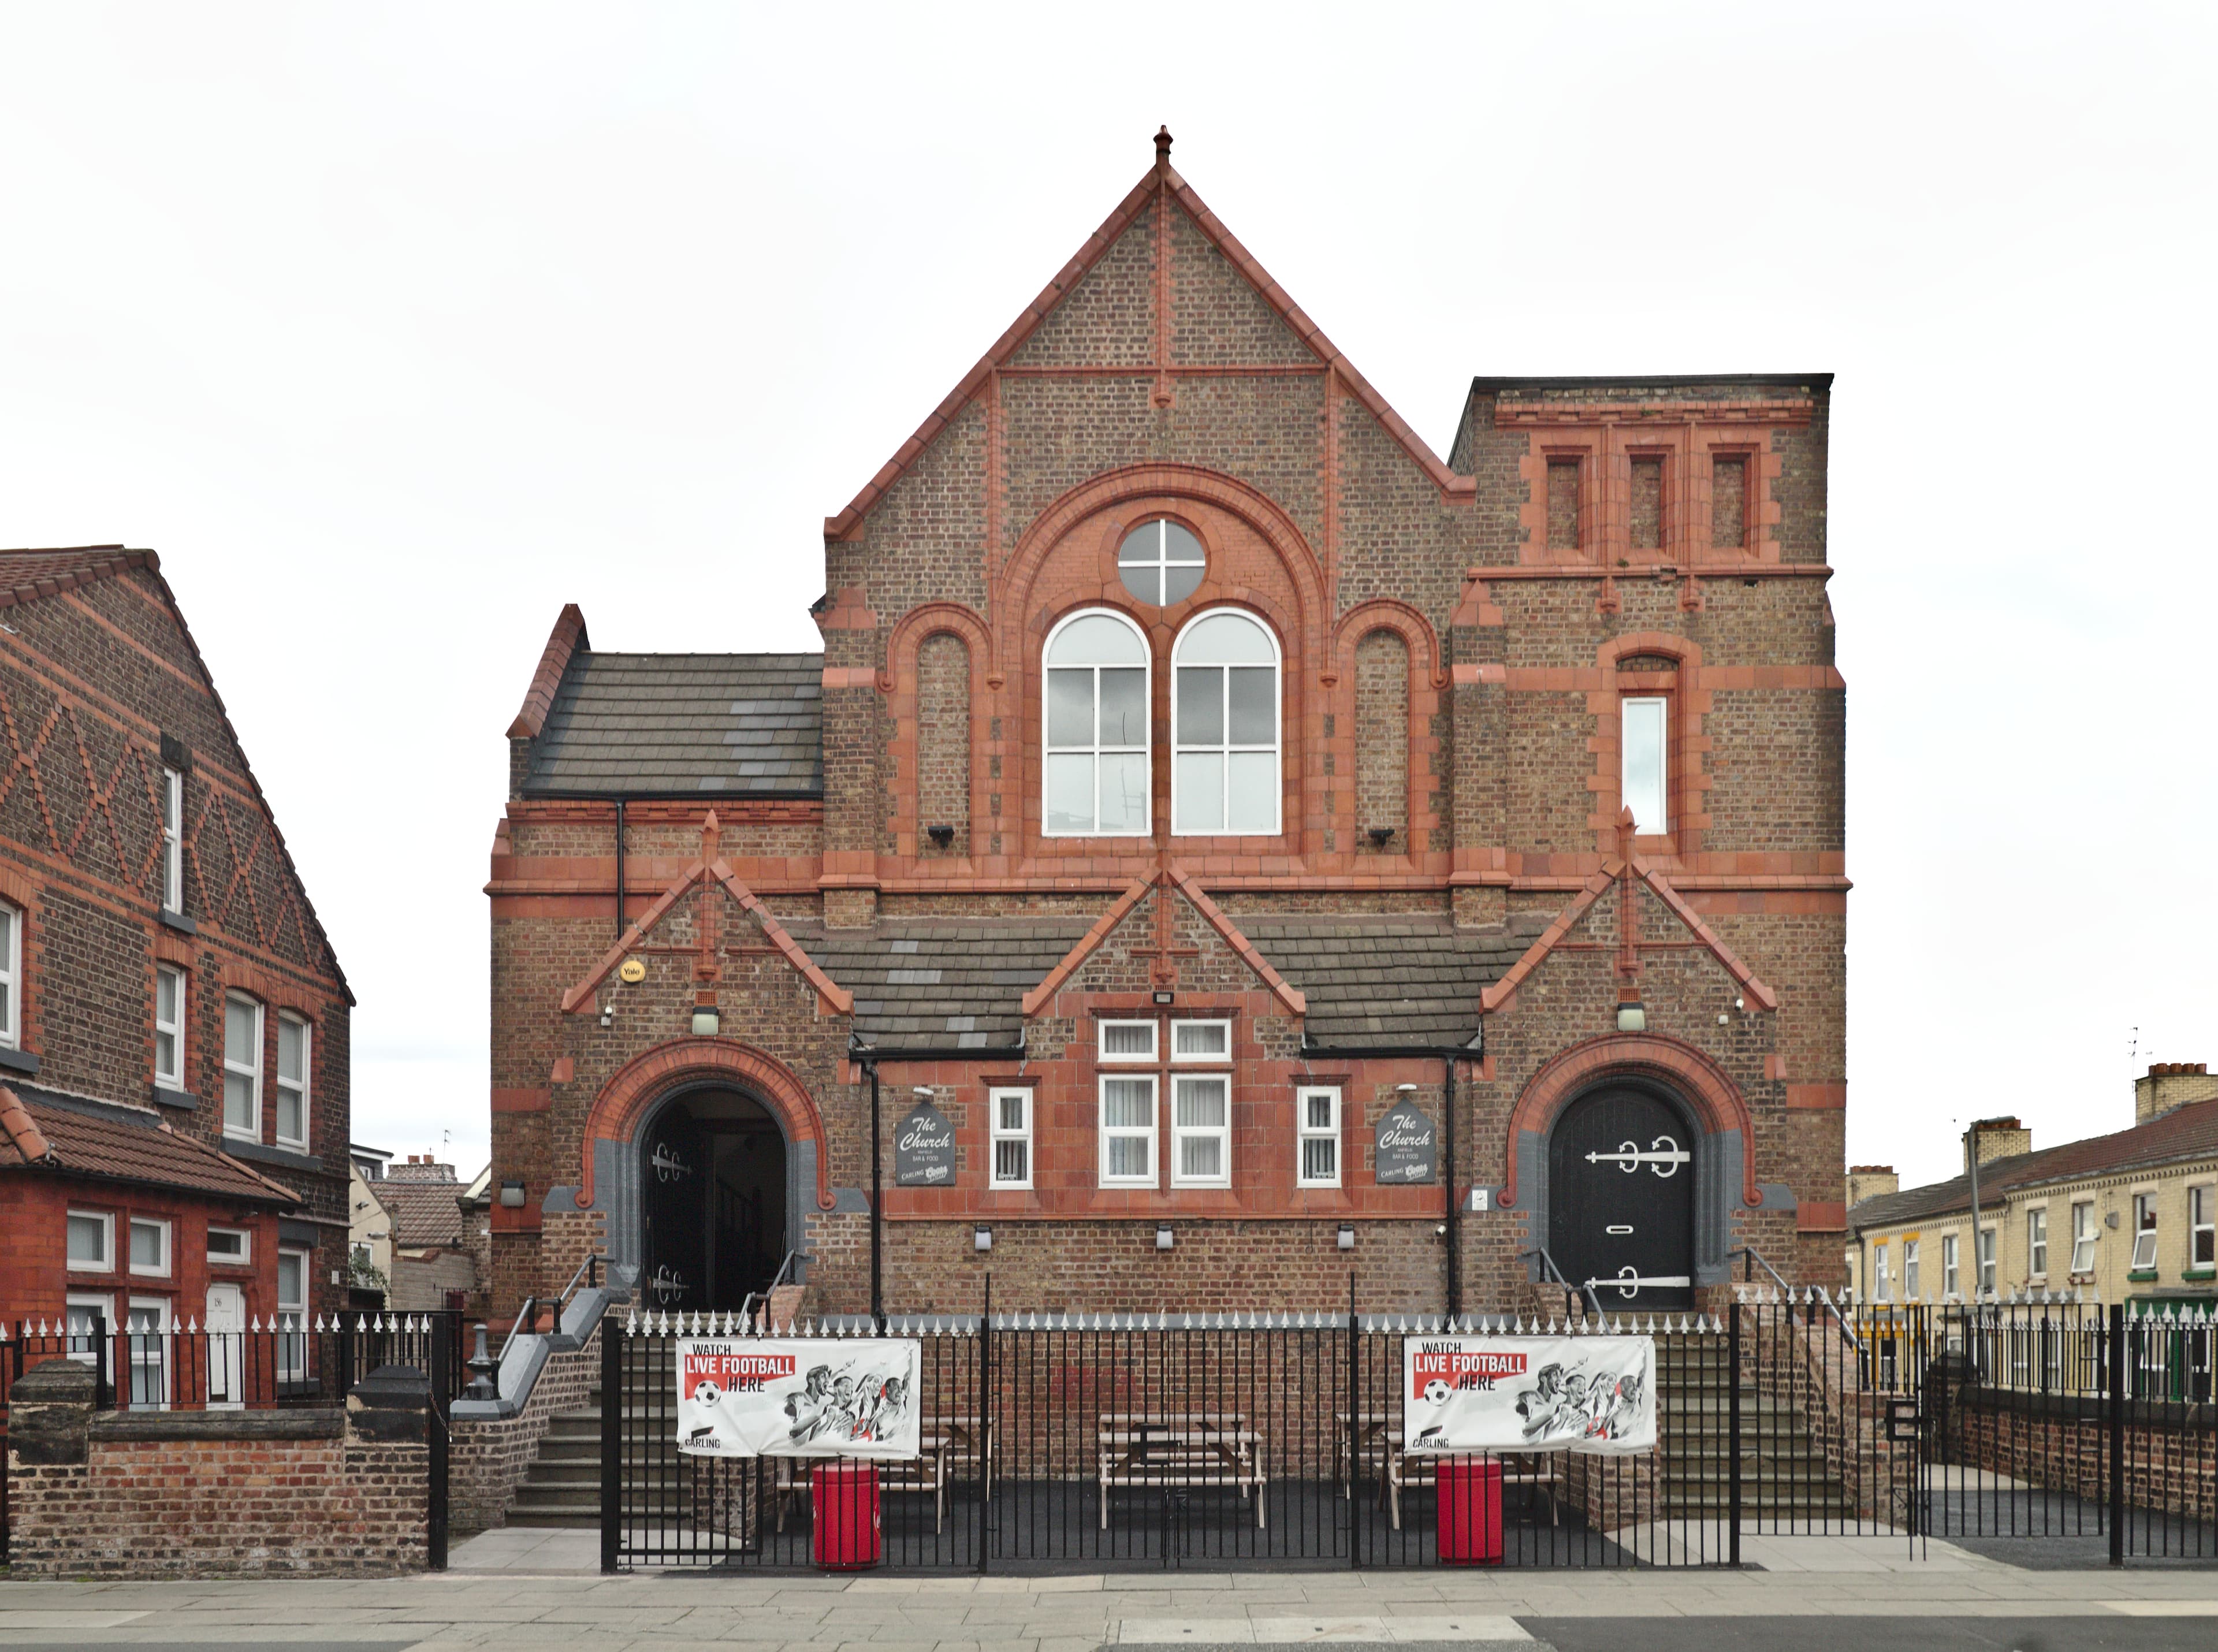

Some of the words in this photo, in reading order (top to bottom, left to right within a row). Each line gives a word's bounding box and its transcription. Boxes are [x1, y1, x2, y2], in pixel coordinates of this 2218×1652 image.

[913, 1117, 936, 1132] The
[1393, 1115, 1416, 1130] The
[900, 1132, 950, 1151] Church
[1379, 1130, 1431, 1149] Church
[902, 1169, 924, 1180] CARLING
[1381, 1167, 1404, 1178] CARLING
[693, 1344, 731, 1356] WATCH
[1421, 1342, 1461, 1355] WATCH
[686, 1357, 717, 1374] LIVE
[721, 1357, 794, 1375] FOOTBALL
[1415, 1355, 1447, 1372] LIVE
[1452, 1355, 1524, 1373] FOOTBALL
[728, 1376, 765, 1392] HERE
[1458, 1374, 1496, 1391] HERE
[685, 1438, 720, 1449] CARLING
[1413, 1438, 1449, 1448] CARLING
